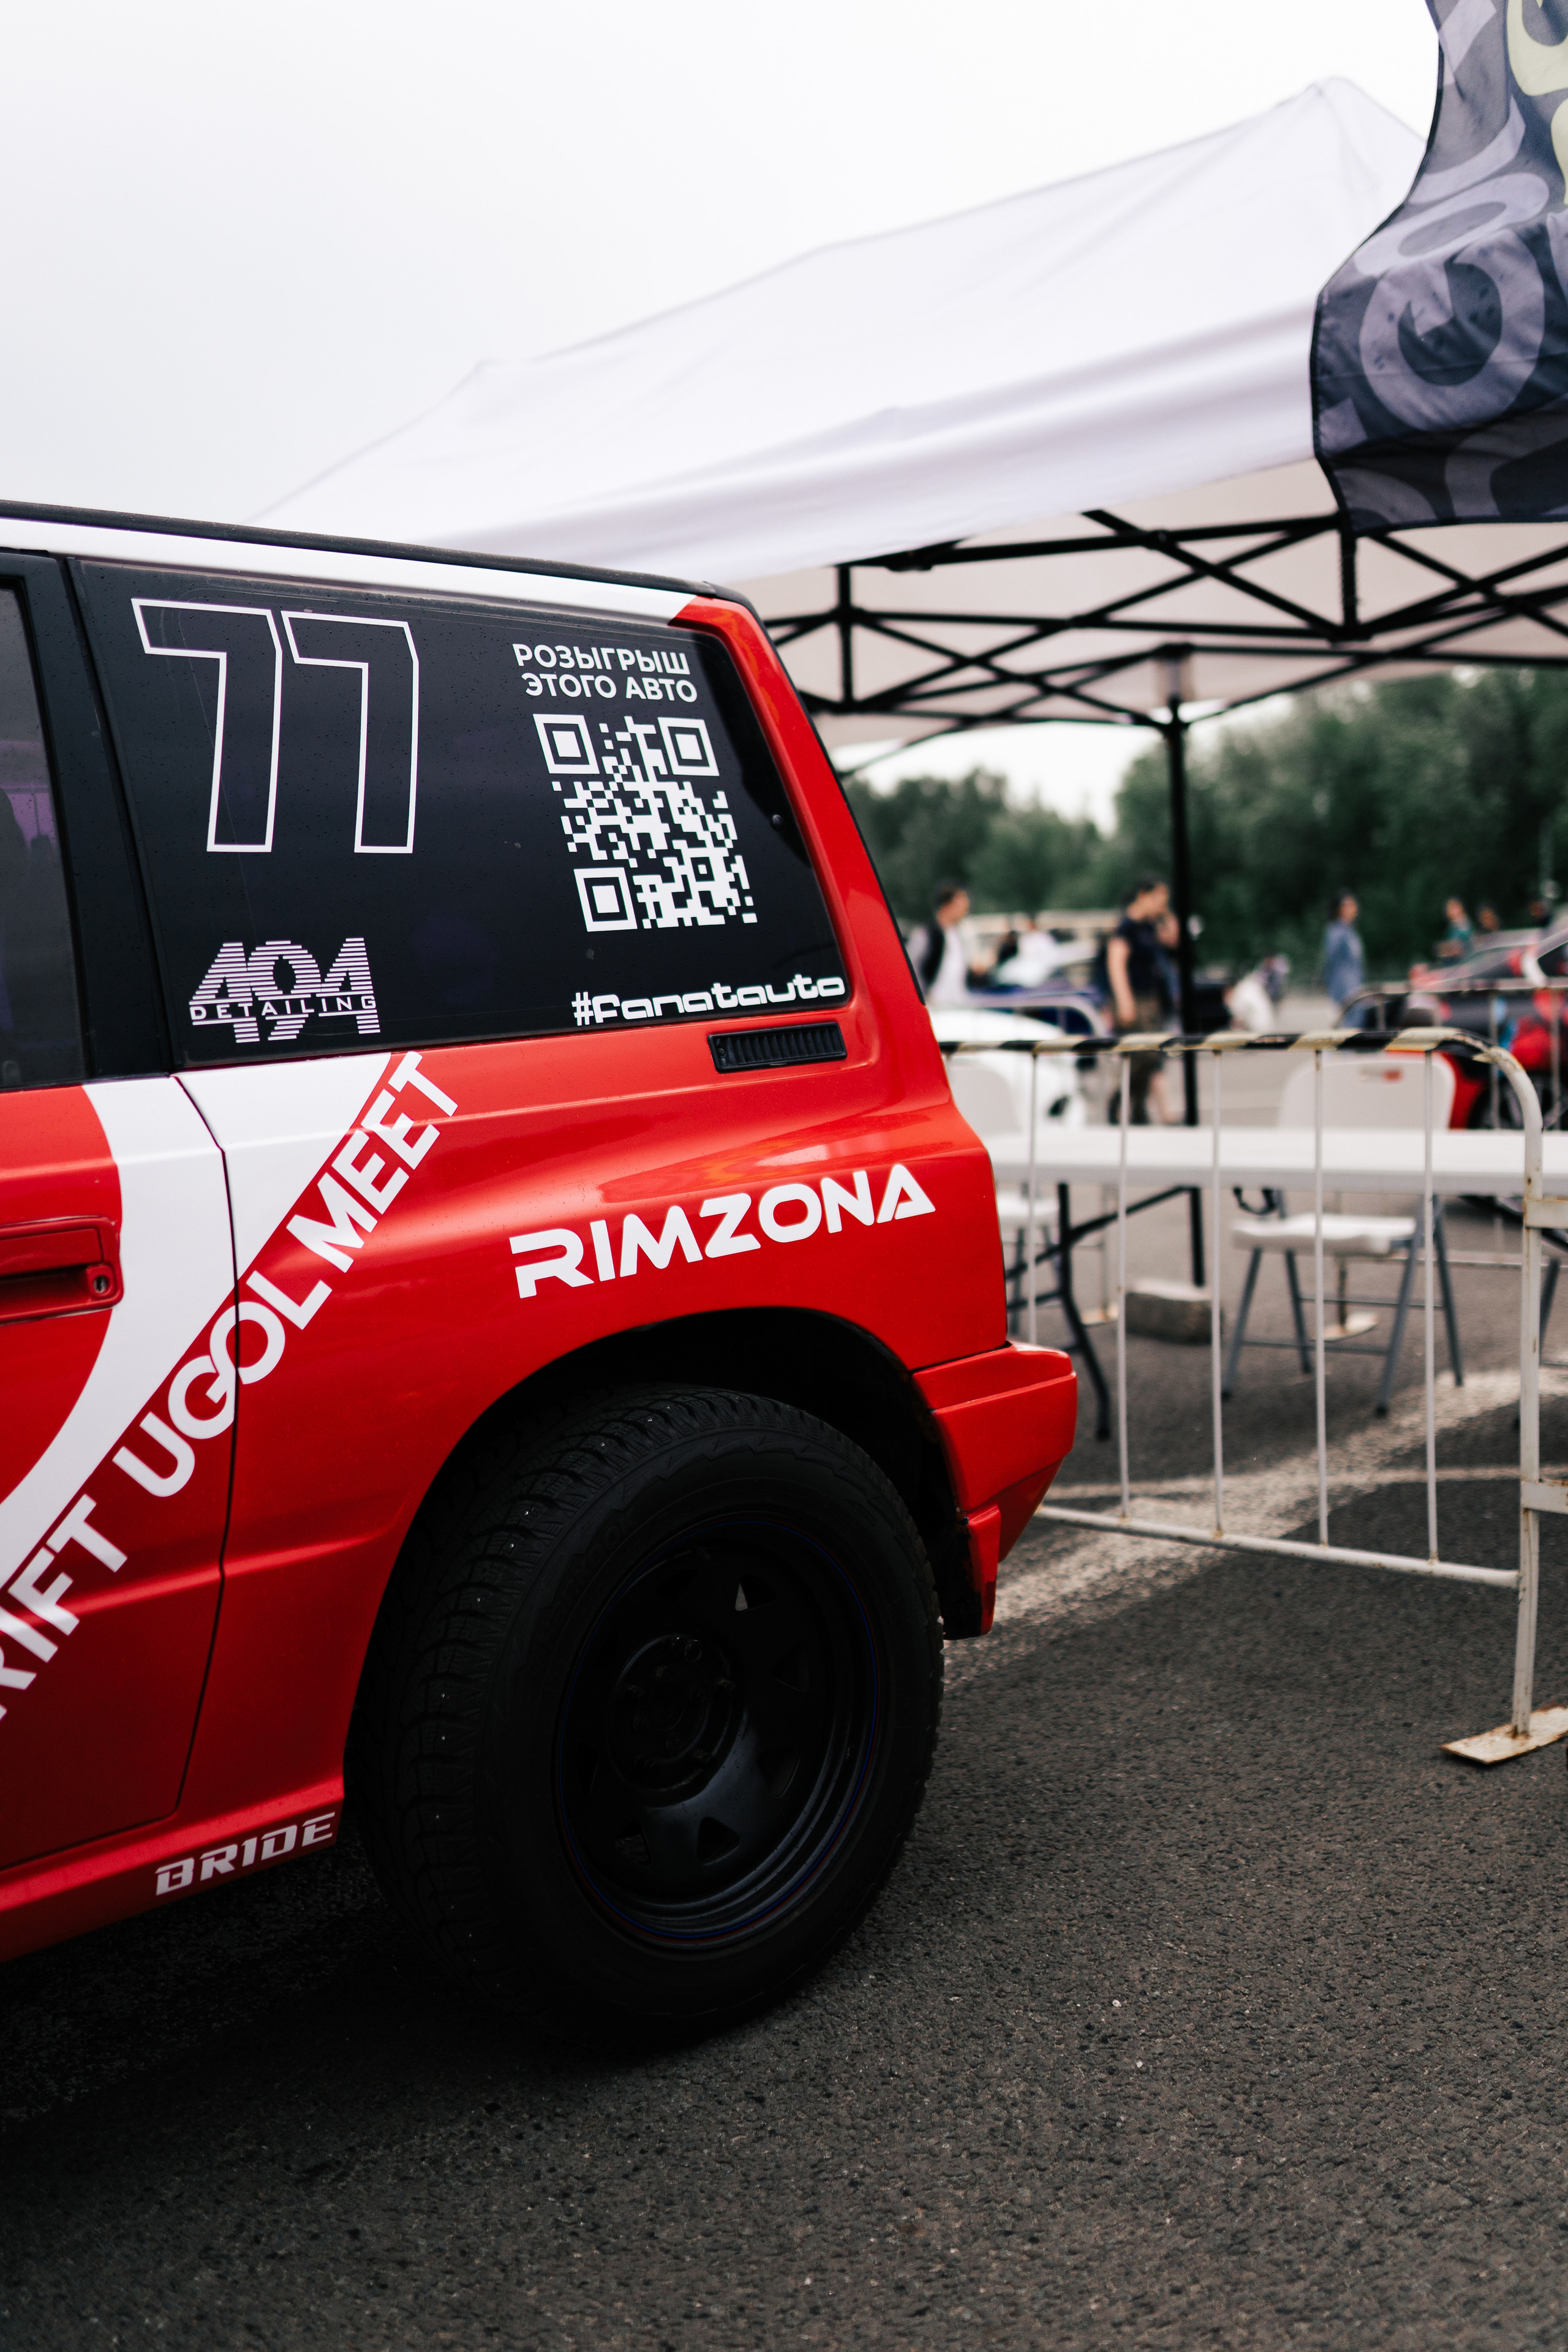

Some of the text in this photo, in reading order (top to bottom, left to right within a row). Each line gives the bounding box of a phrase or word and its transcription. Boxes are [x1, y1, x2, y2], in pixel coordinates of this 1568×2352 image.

[512, 643, 690, 675] РОЗЫГРЫШ
[525, 673, 698, 703] ЭТОГО АВТО
[131, 598, 419, 853] 77
[189, 937, 381, 1043] 404
[189, 995, 376, 1020] DETAILING
[571, 974, 845, 1026] #fanatauto
[112, 1270, 332, 1497] UGOL
[286, 1050, 458, 1273] MEET
[509, 1164, 936, 1298] RIMZONA
[155, 1811, 336, 1896] BRIDE
